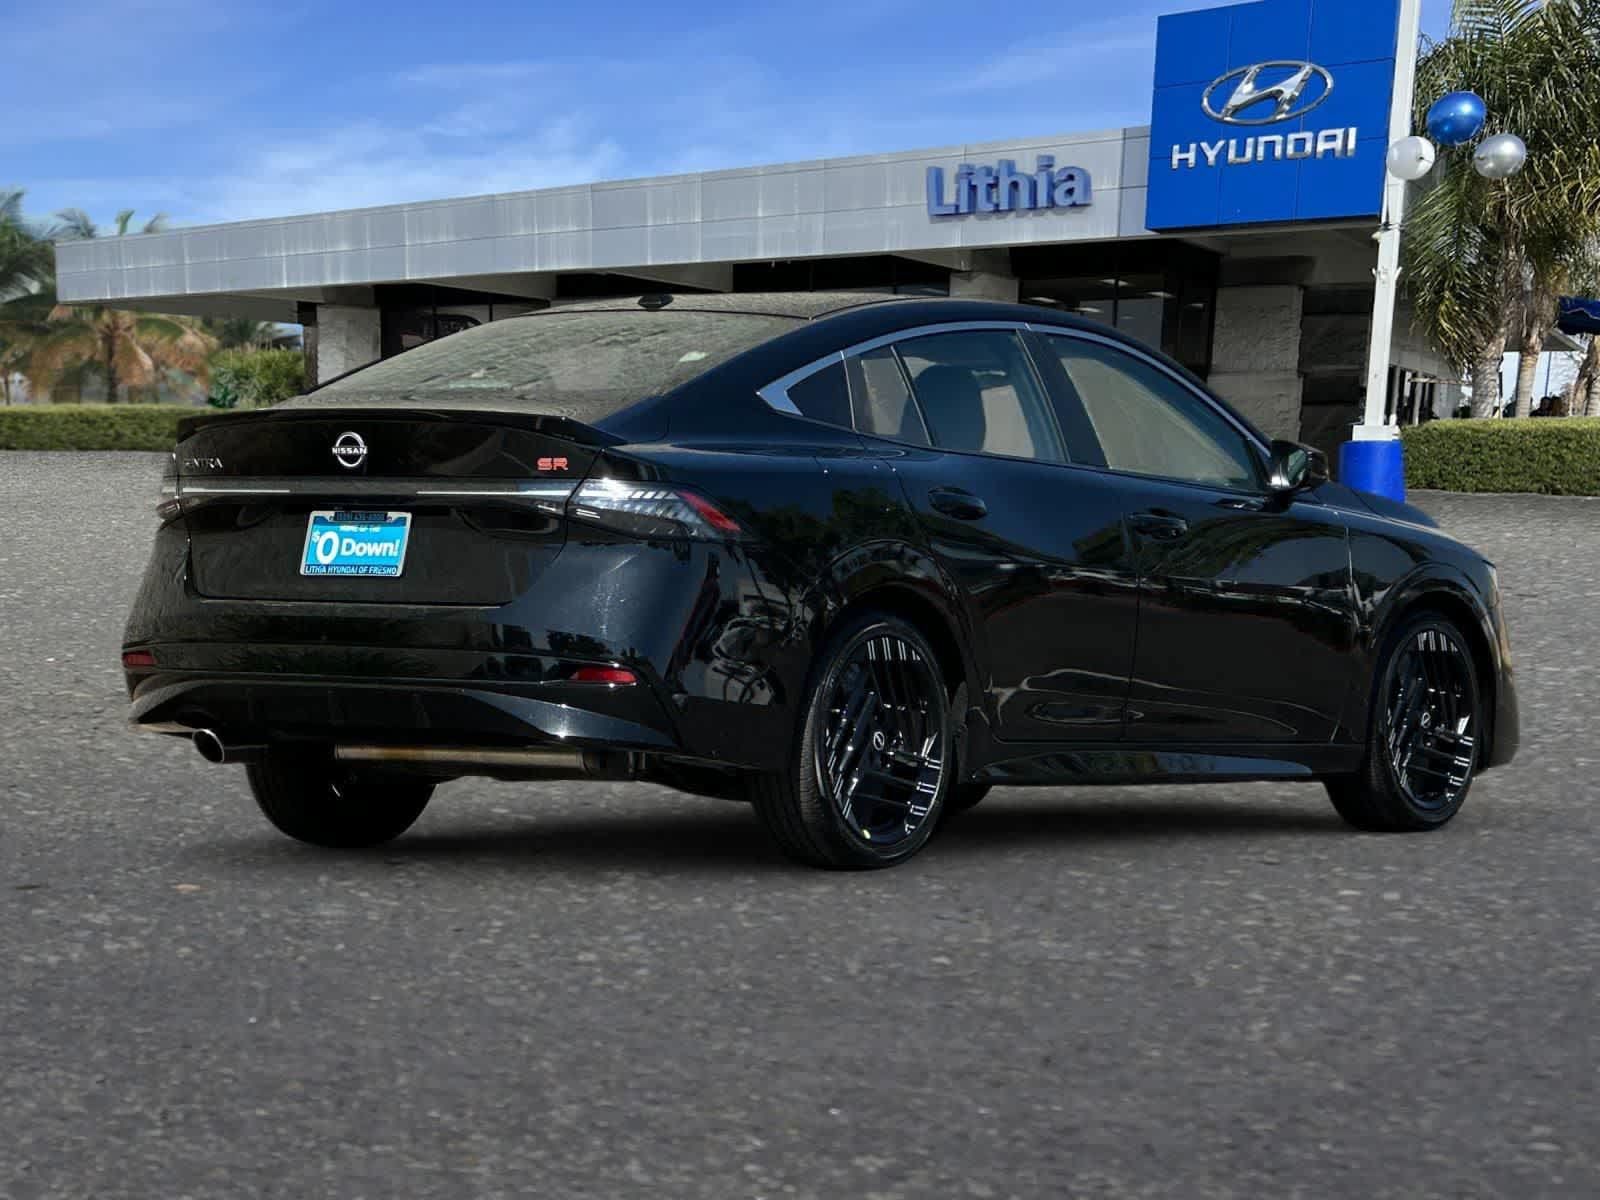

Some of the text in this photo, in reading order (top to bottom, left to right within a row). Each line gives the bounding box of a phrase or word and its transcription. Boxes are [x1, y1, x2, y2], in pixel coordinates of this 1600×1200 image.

[1171, 127, 1358, 169] HYUNDAI
[926, 154, 1093, 216] Lithia
[332, 446, 368, 455] NISSAN
[537, 457, 569, 471] SR
[341, 538, 400, 556] Down!
[305, 565, 398, 575] LITHIA HYUNDAI OF FRESNO
